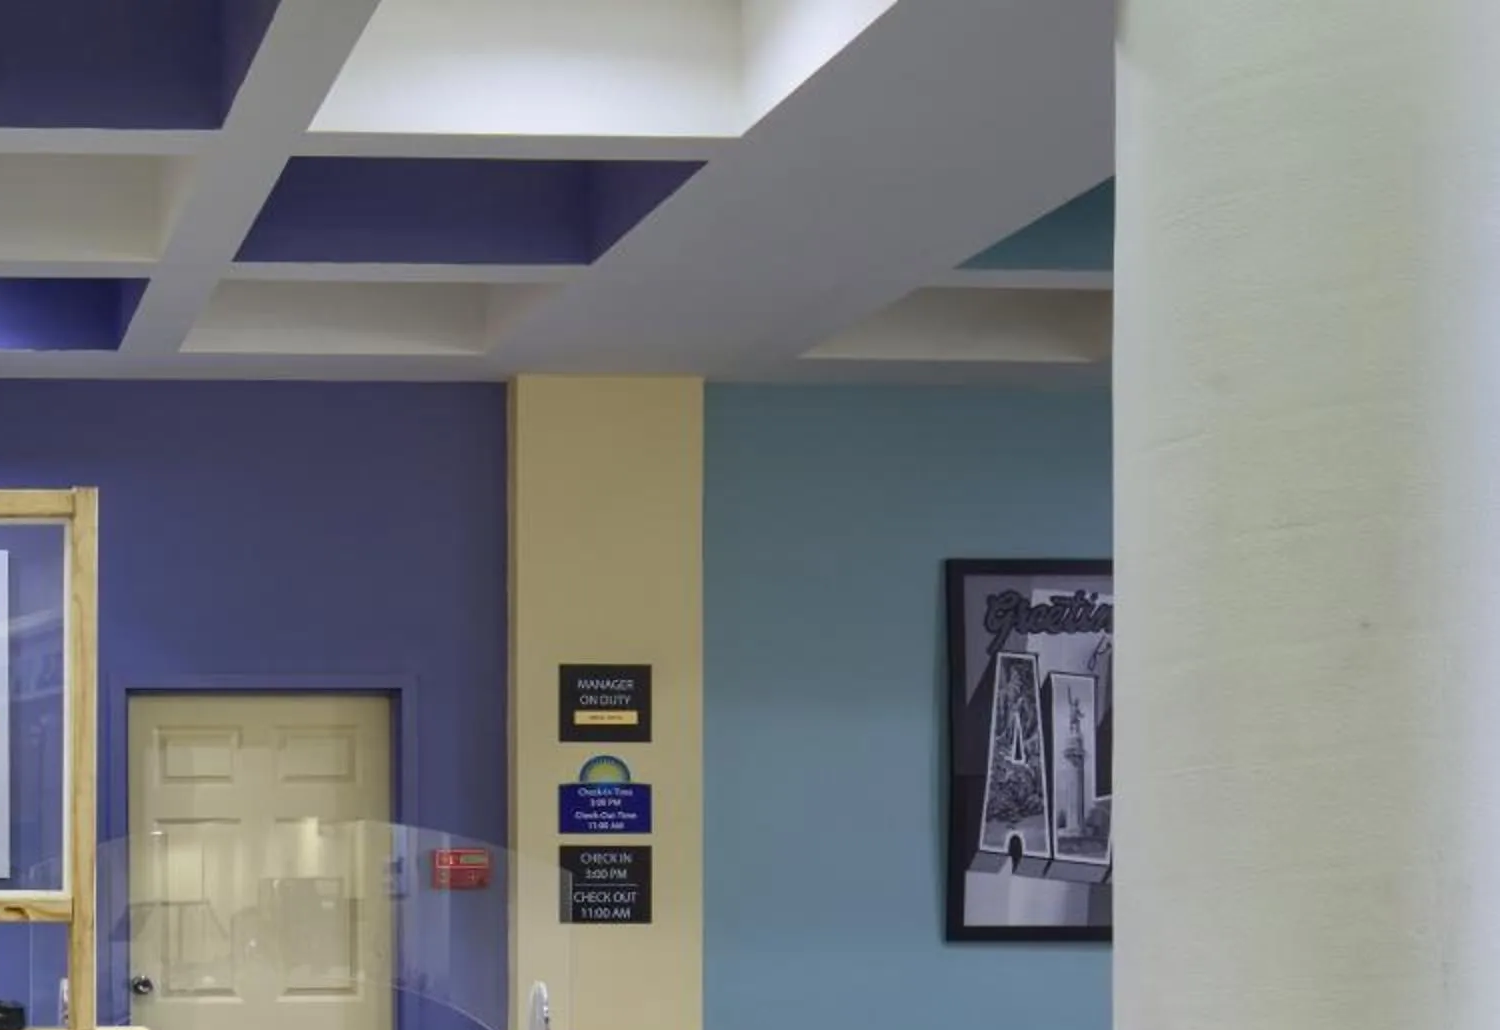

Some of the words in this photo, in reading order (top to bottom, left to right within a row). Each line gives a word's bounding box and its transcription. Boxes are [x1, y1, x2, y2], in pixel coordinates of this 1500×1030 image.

[577, 678, 635, 690] MANAGER
[579, 694, 598, 705] ON
[599, 694, 631, 705] DUTY
[580, 852, 618, 865] CHECK
[619, 852, 633, 864] IN
[609, 867, 628, 880] PM
[574, 891, 612, 904] CHECK
[613, 891, 637, 904] OUT
[581, 907, 611, 919] 11:00
[612, 907, 631, 919] AM
